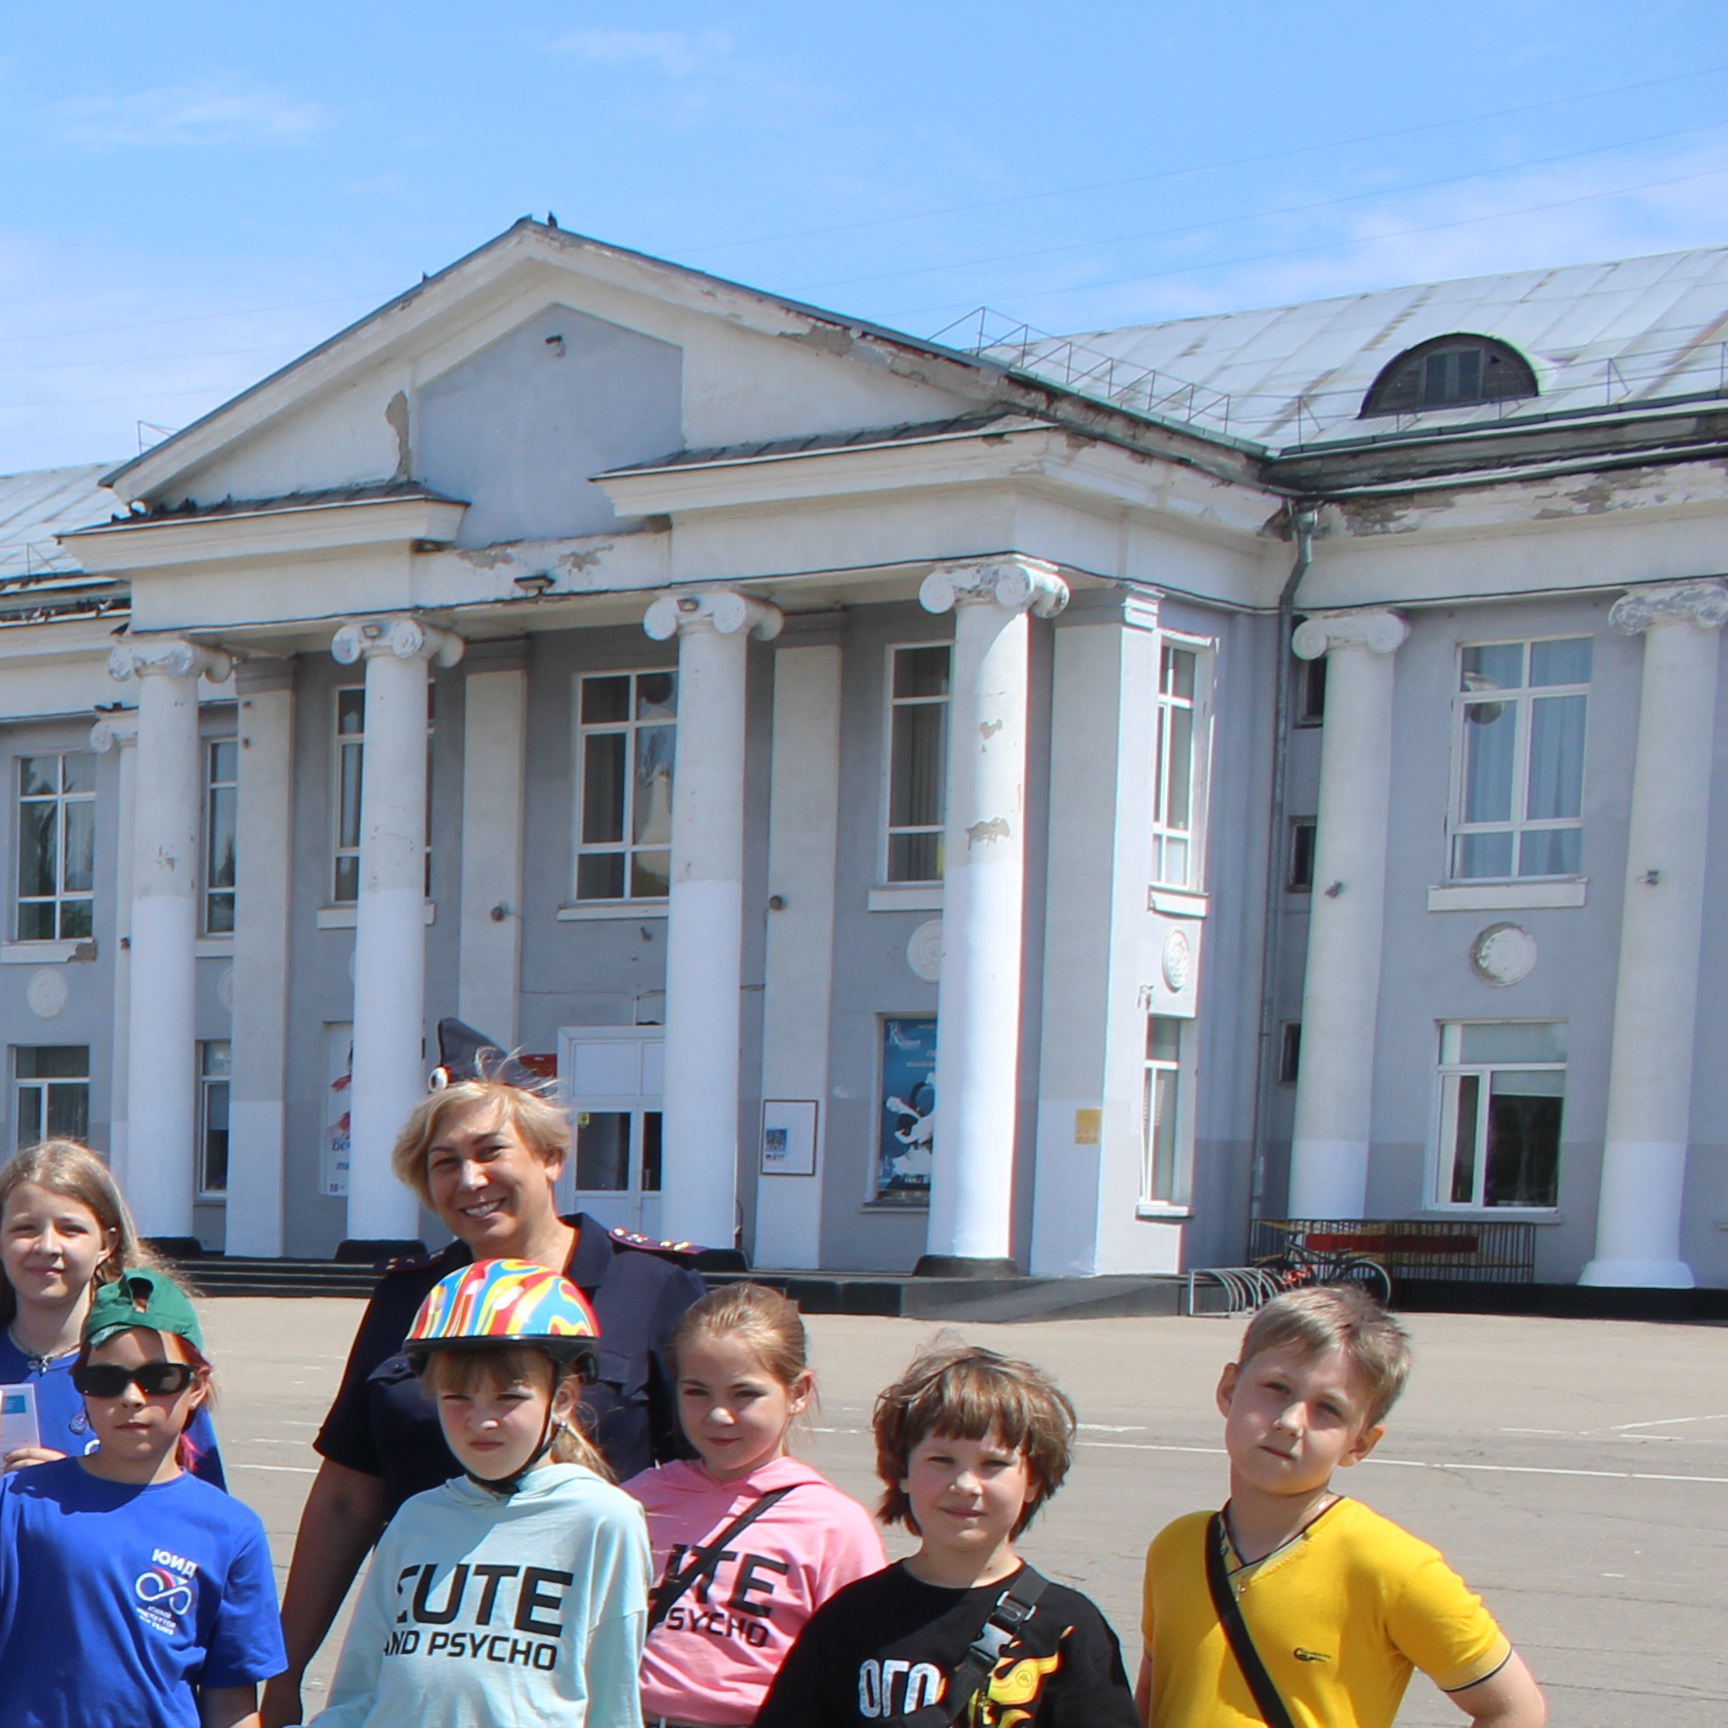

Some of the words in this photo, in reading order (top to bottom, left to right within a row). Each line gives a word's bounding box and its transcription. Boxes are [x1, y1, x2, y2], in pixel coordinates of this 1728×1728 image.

[152, 1548, 199, 1578] ЮИД
[665, 1607, 769, 1647] SYCHO
[426, 1631, 558, 1671] PSYCHO
